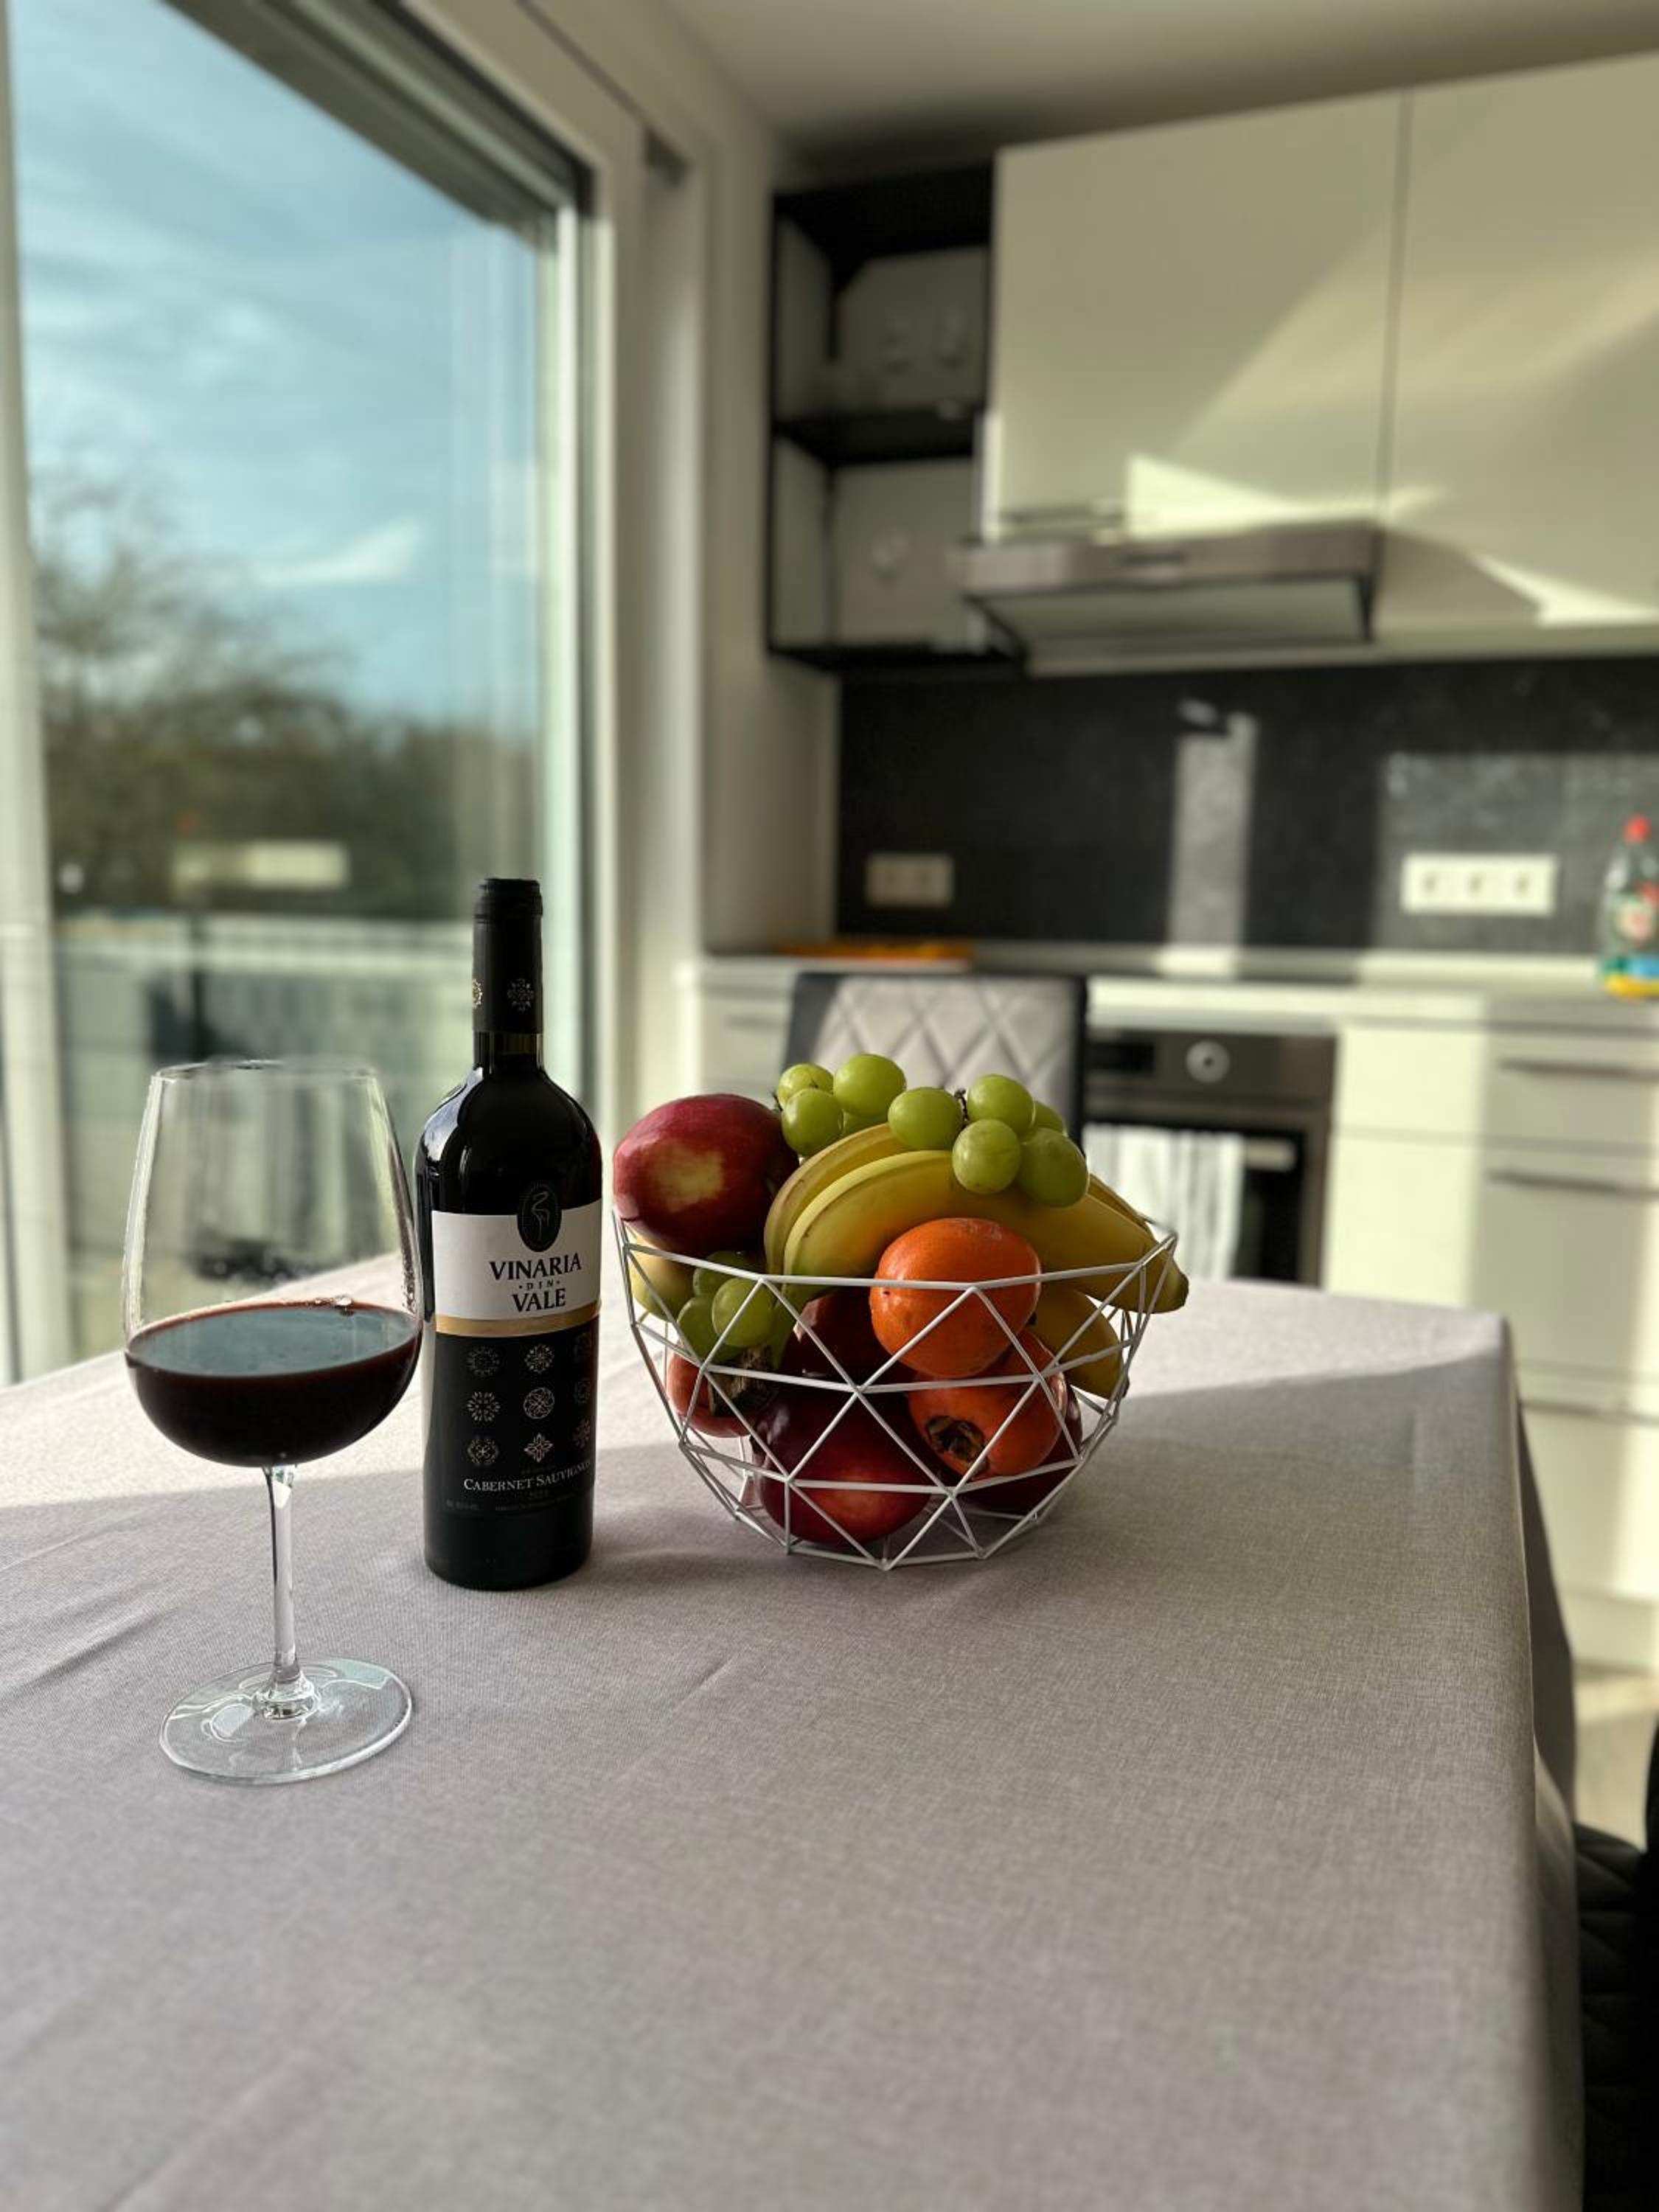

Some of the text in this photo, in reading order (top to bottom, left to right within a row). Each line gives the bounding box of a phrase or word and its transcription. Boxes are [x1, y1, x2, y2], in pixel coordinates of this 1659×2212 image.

[490, 1253, 582, 1280] VINARIA
[512, 1288, 566, 1312] VALE
[463, 1478, 533, 1492] CABERNET
